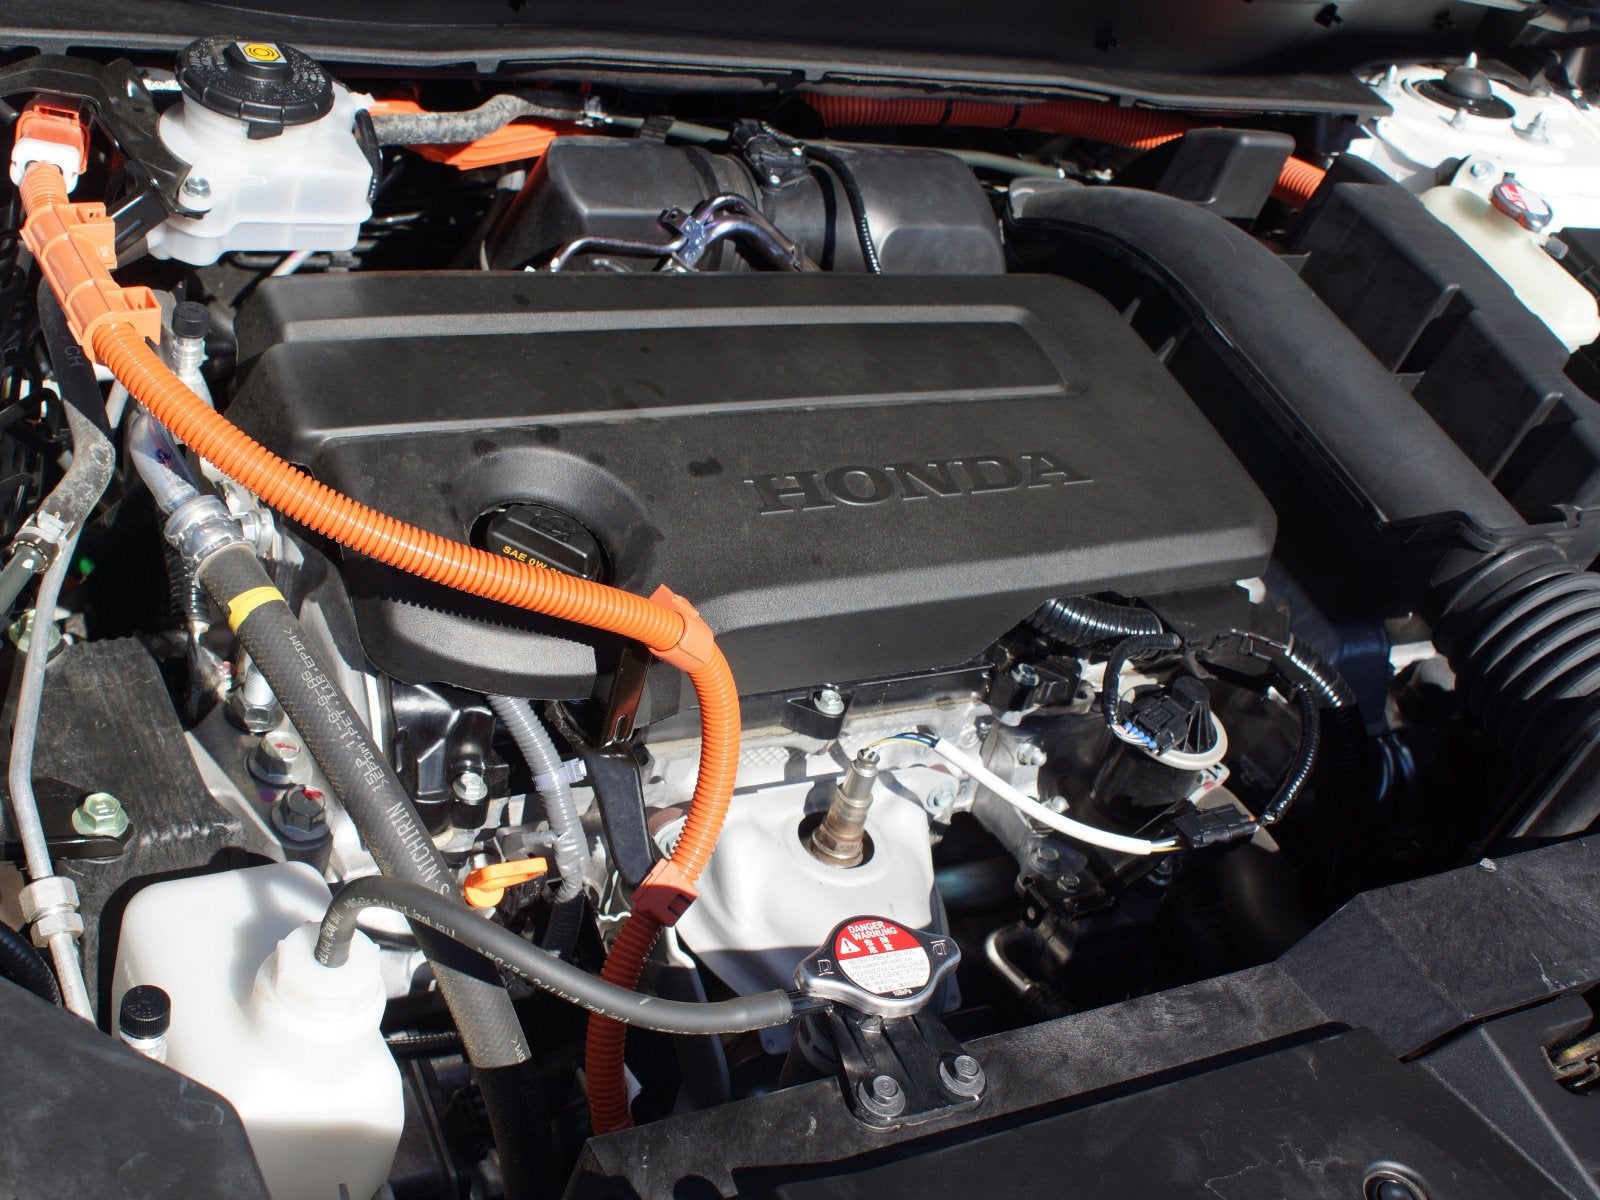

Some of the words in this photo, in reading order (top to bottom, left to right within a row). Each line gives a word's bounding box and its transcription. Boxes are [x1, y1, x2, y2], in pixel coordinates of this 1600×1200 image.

[741, 452, 1095, 516] HONDA
[502, 545, 528, 562] SAE
[847, 921, 886, 934] DANGER
